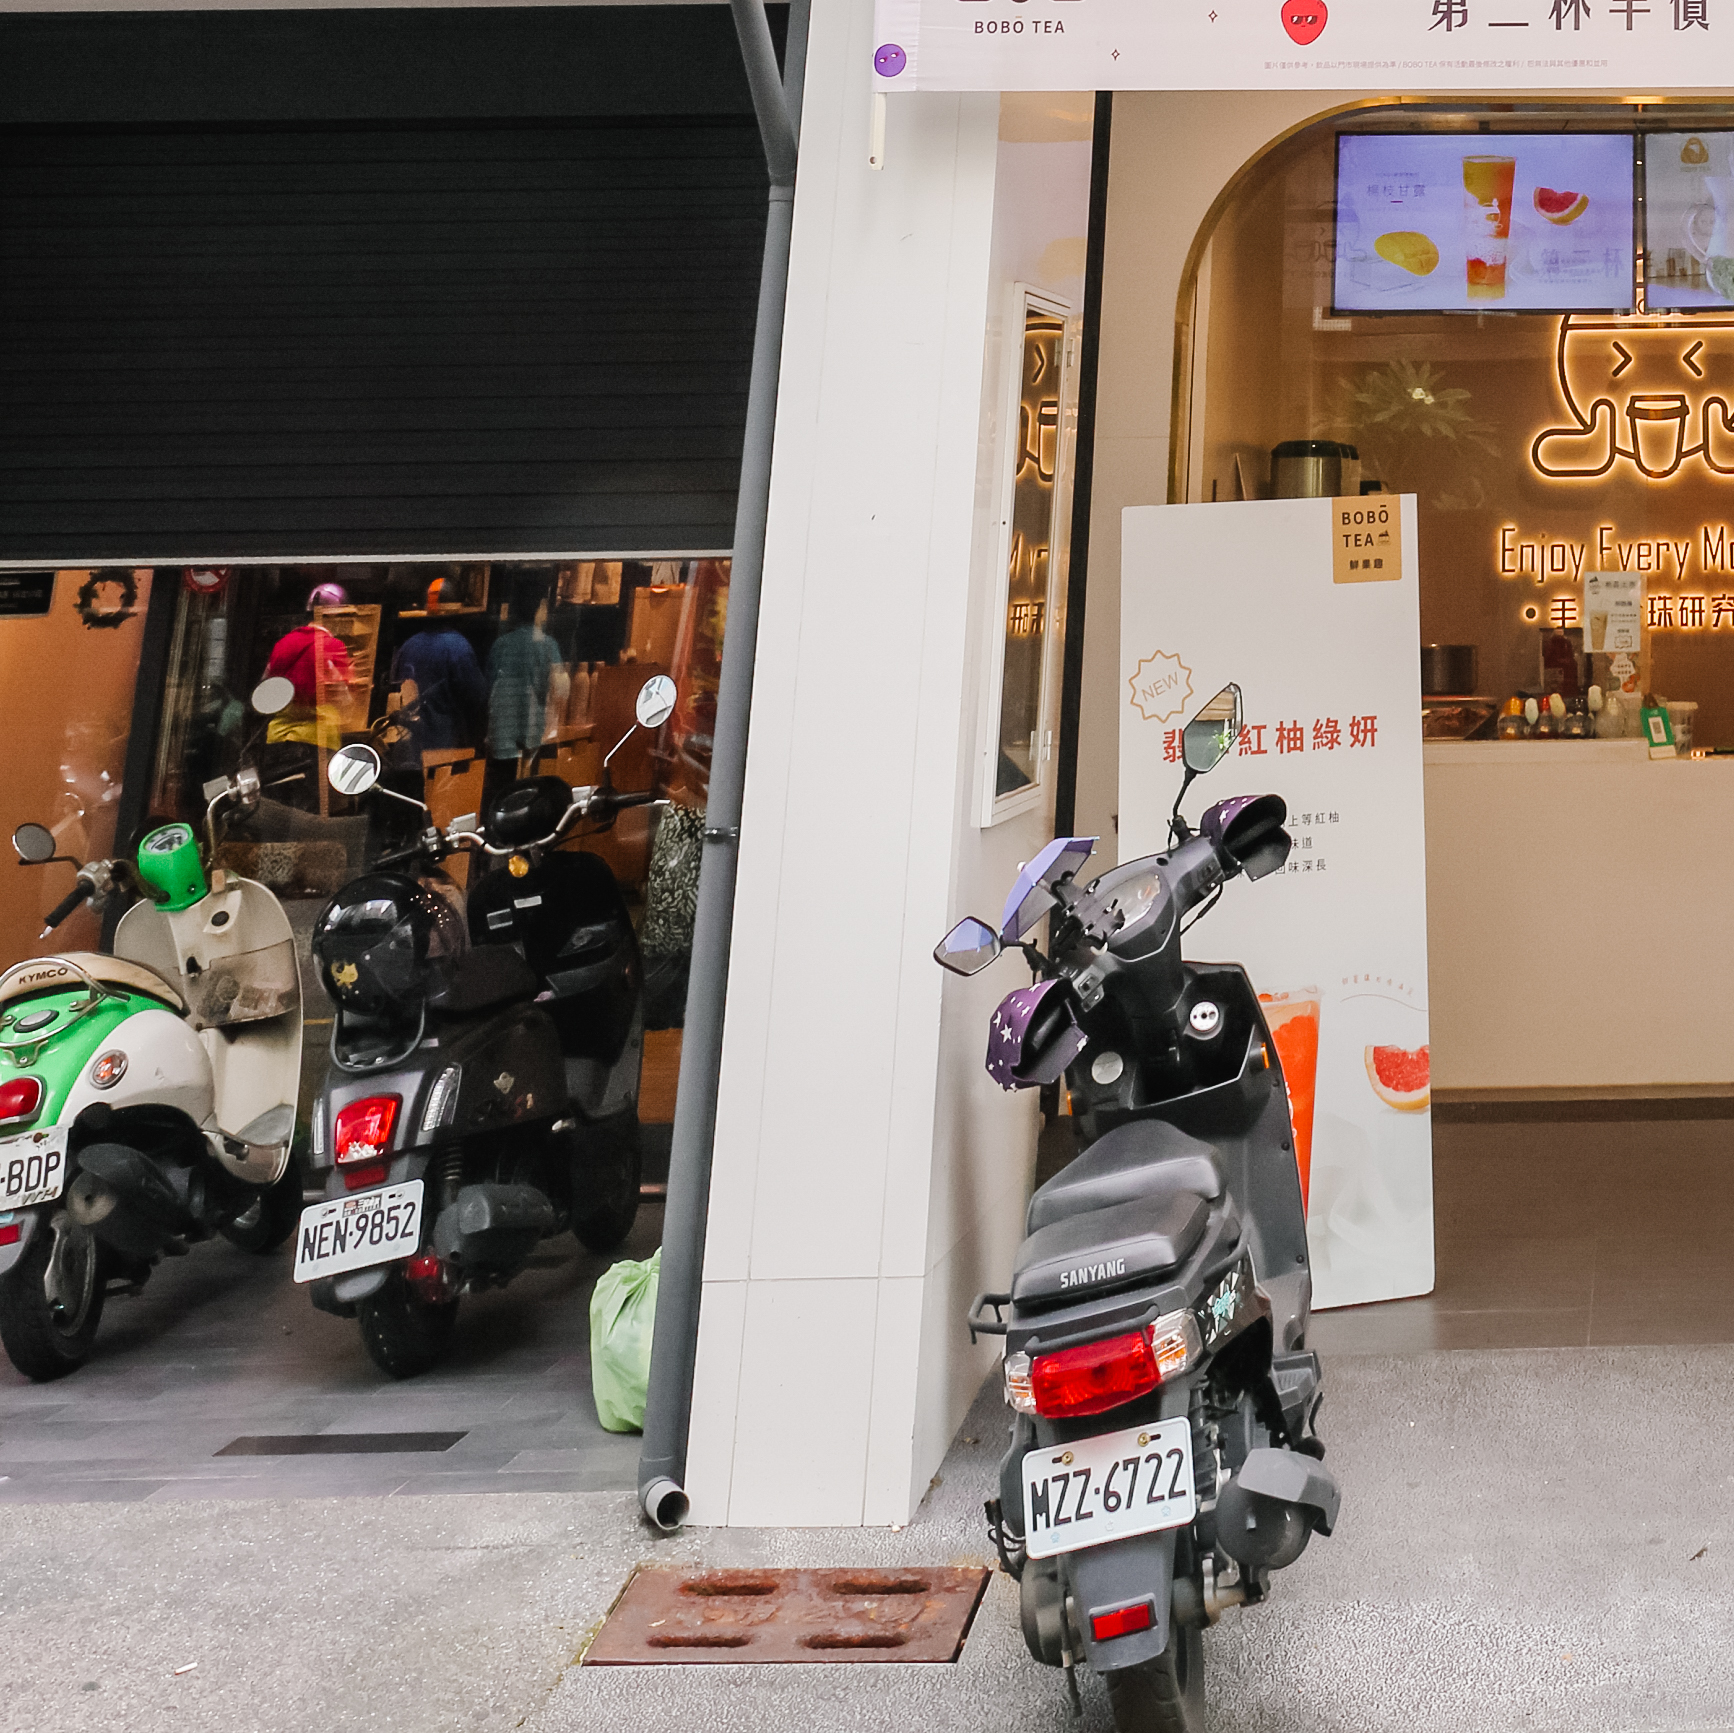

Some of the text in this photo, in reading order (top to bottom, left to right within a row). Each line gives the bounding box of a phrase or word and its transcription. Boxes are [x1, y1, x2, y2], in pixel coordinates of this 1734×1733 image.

[1032, 20, 1065, 34] TEA
[1342, 532, 1374, 548] TEA
[1501, 526, 1585, 584] Enjoy
[1141, 671, 1180, 702] NEW
[18, 965, 69, 986] KYMCO
[1059, 1258, 1126, 1290] SANYANG
